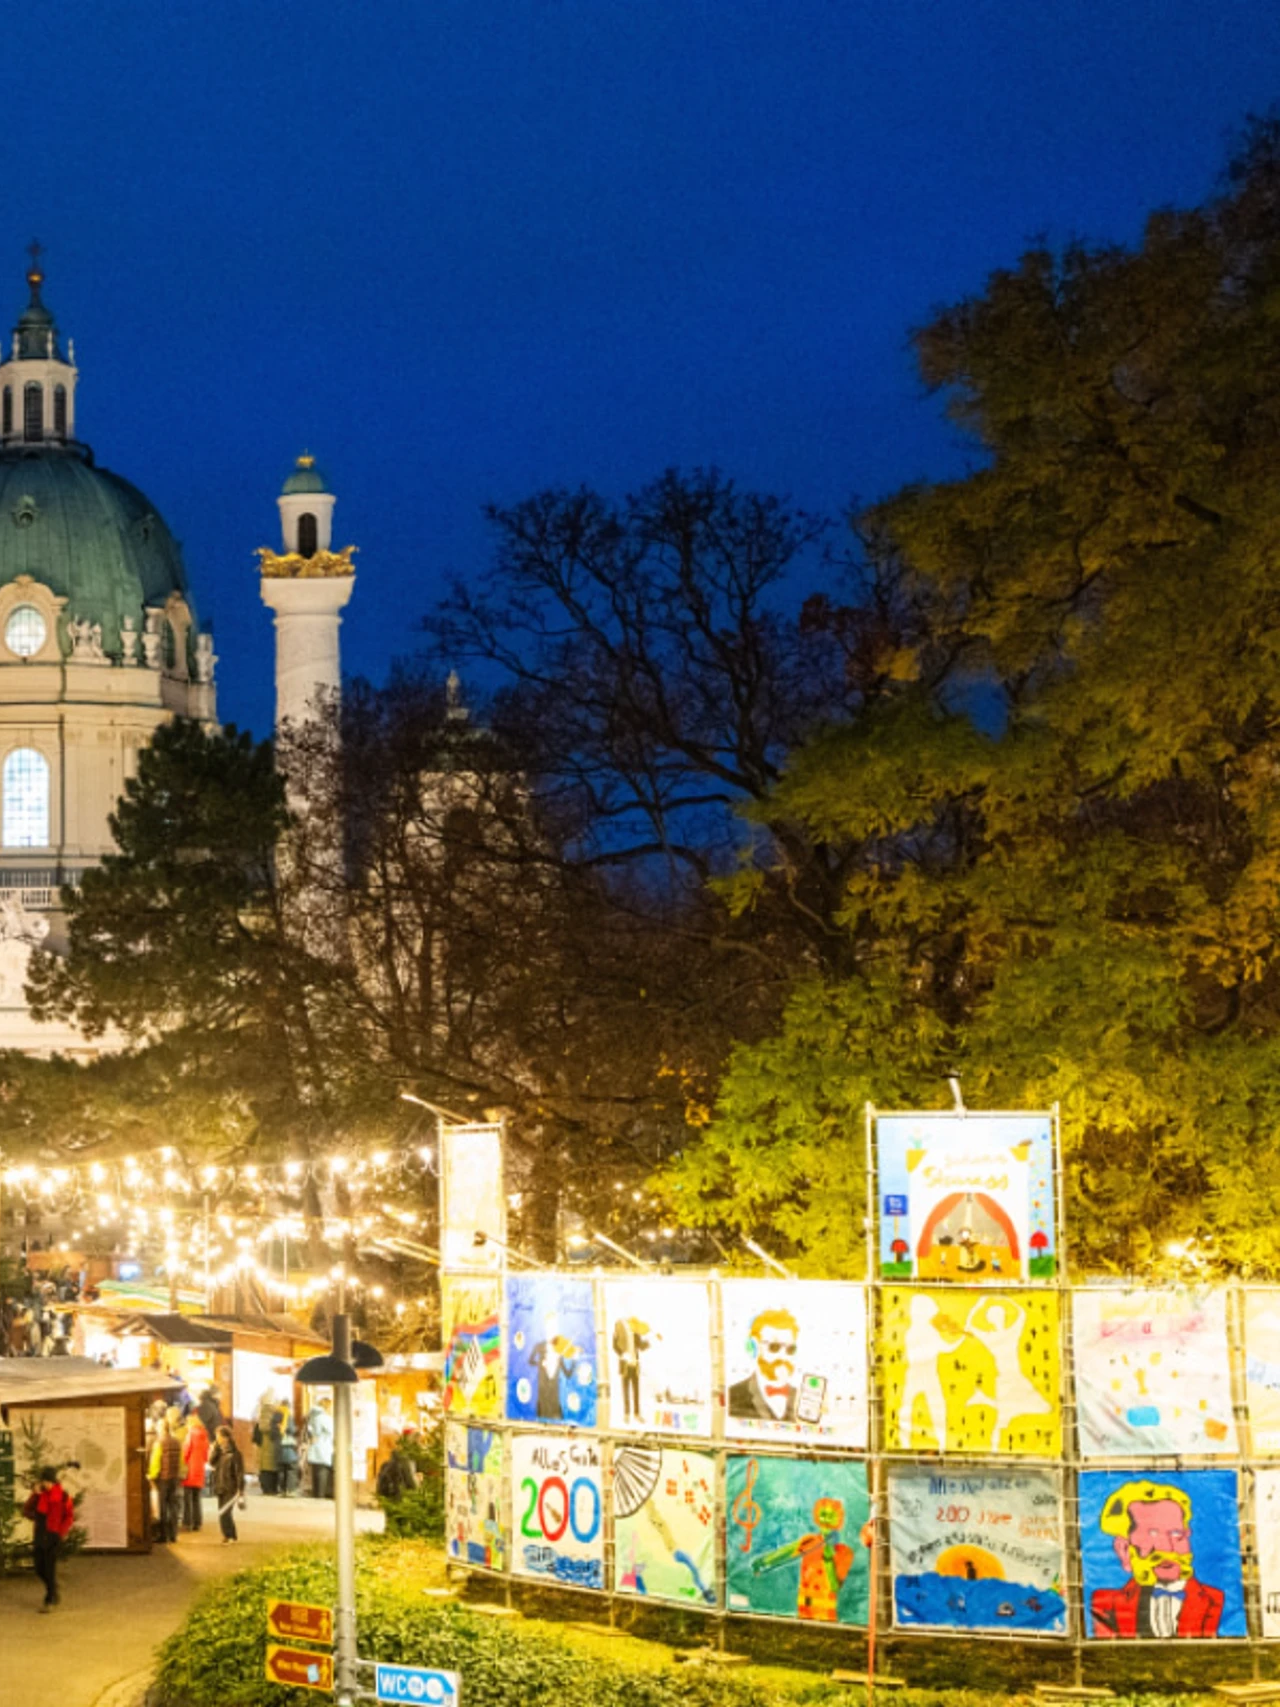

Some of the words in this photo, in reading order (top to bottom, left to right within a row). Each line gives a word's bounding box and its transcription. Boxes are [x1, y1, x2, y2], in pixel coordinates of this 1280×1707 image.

[532, 1447, 568, 1475] Alles
[520, 1476, 601, 1544] 200
[936, 1504, 970, 1523] 200
[380, 1672, 407, 1696] WC
